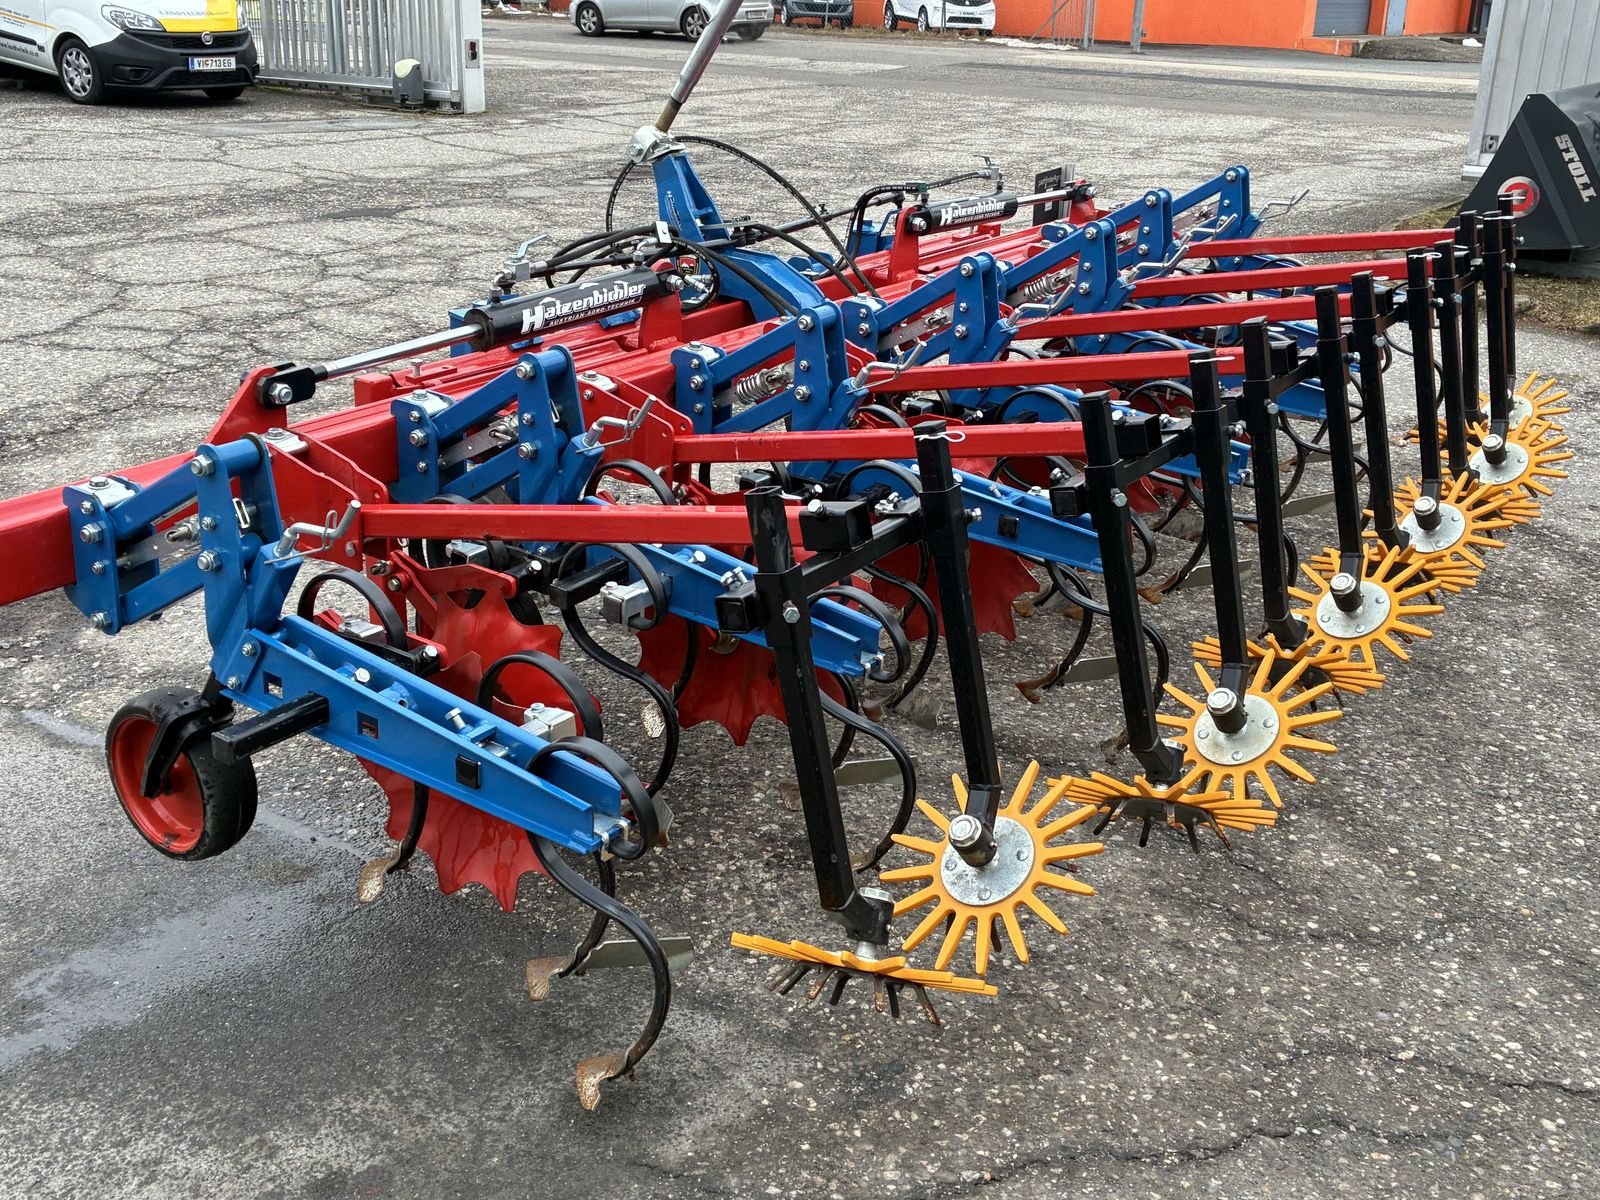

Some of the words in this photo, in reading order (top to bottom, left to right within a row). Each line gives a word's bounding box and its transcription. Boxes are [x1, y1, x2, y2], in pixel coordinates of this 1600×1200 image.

[1554, 133, 1597, 203] STOLL
[939, 196, 1006, 227] Hatzenbichler
[521, 280, 647, 334] Hatzenbichler
